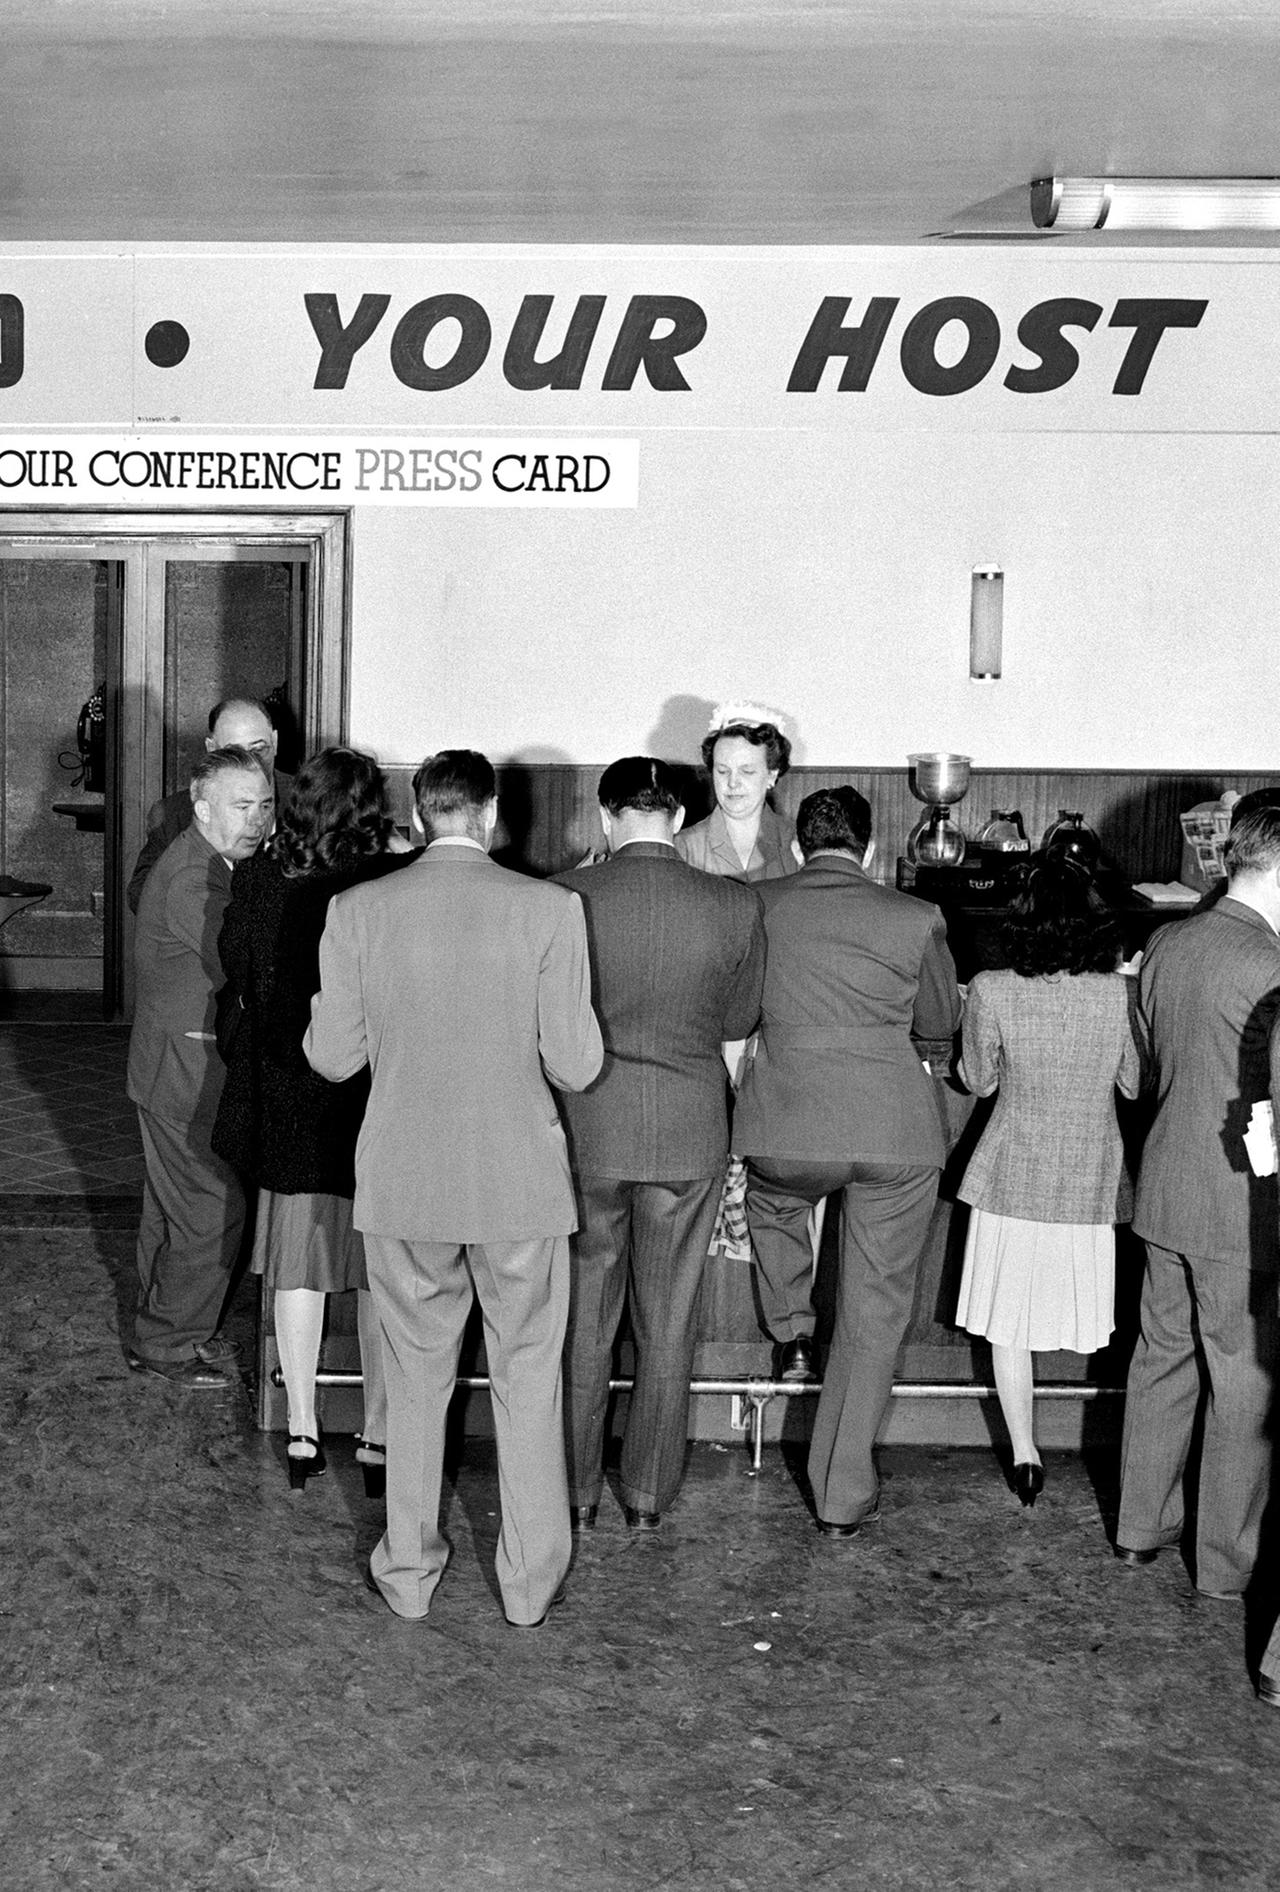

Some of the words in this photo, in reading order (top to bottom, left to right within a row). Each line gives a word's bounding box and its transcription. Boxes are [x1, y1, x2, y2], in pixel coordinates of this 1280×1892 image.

[303, 293, 708, 392] YOUR
[786, 296, 1210, 397] HOST
[88, 449, 342, 491] CONFERENCE
[355, 449, 482, 491] PRESS
[491, 453, 611, 493] CARD
